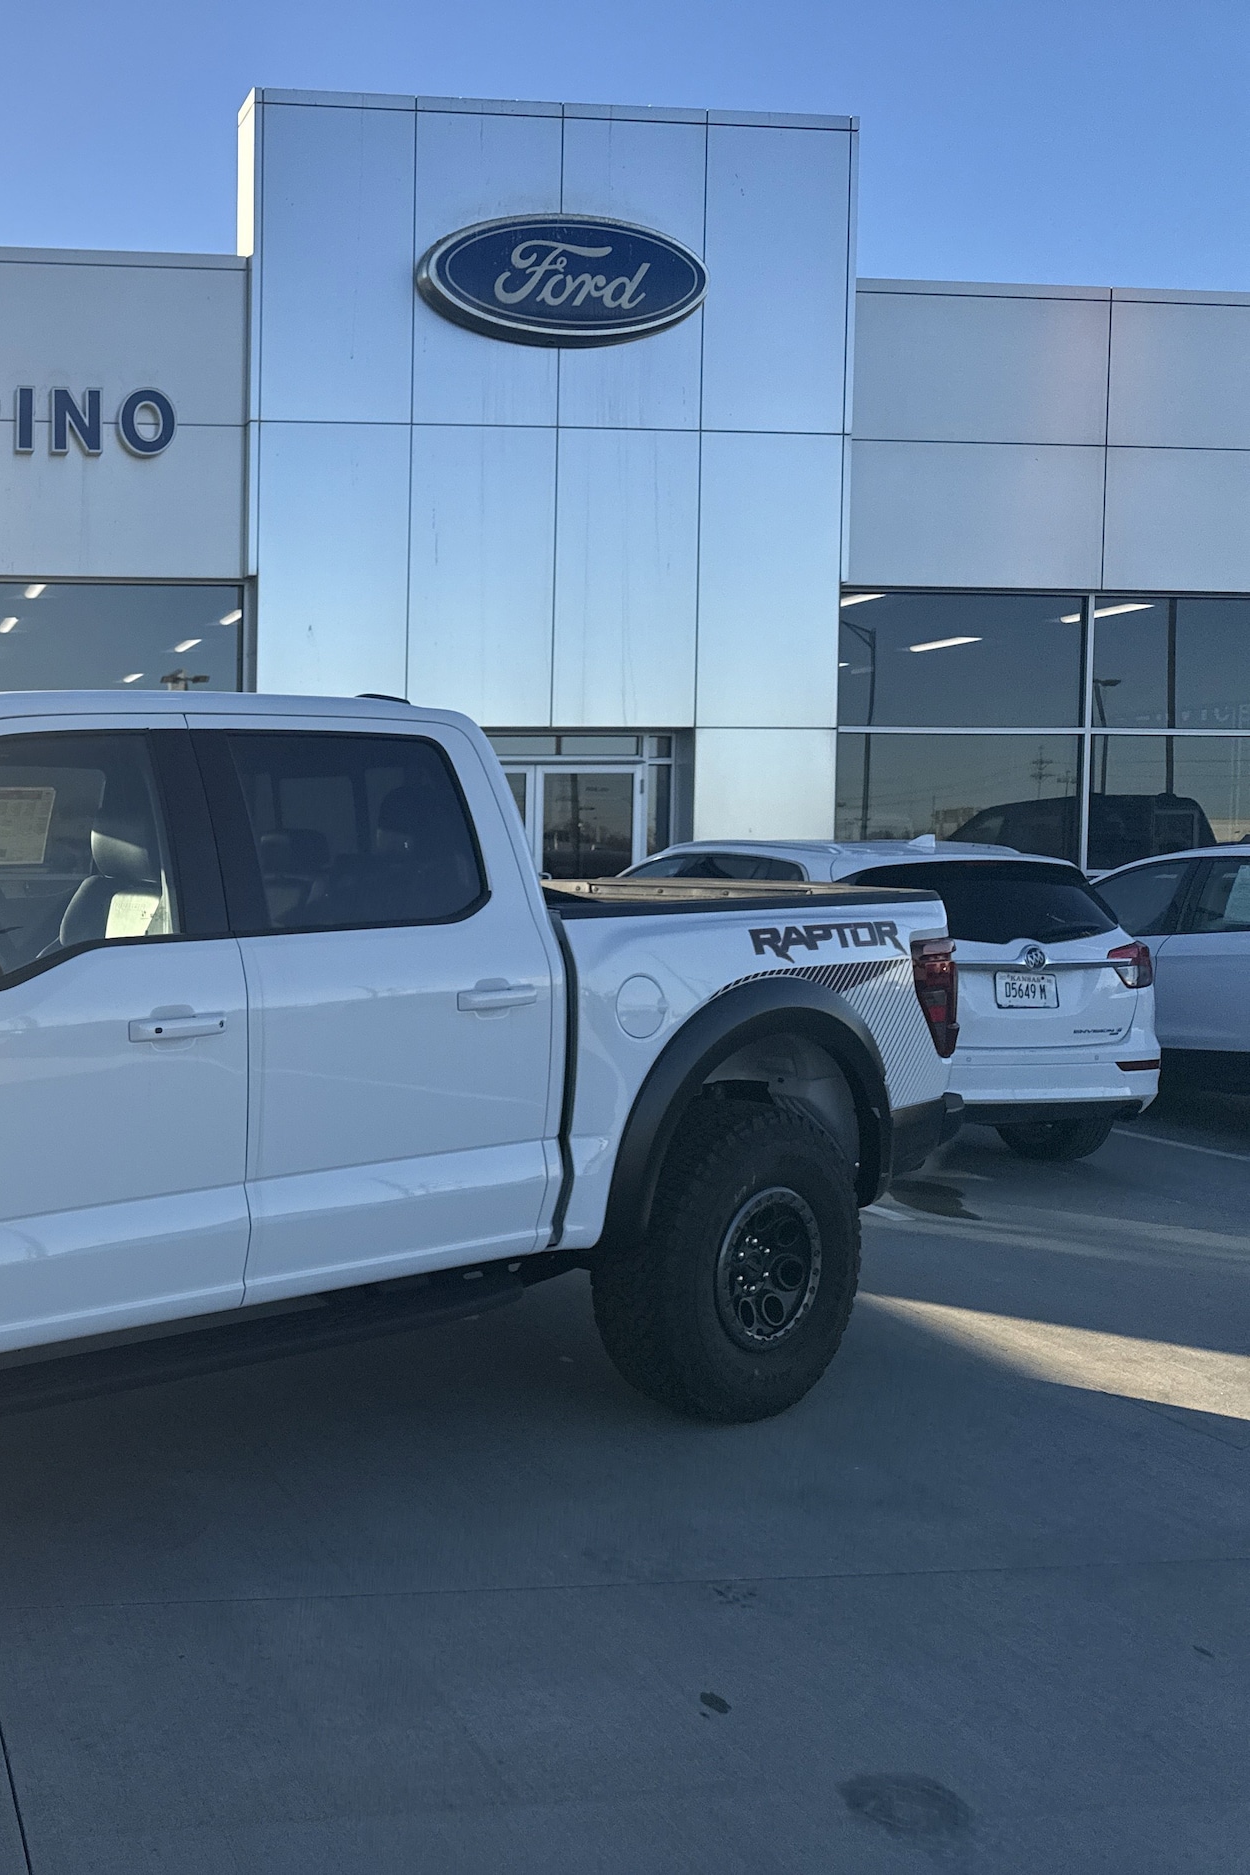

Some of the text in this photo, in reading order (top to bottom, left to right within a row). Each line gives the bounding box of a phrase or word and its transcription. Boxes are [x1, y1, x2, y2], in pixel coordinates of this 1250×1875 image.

[493, 239, 651, 310] Ford
[748, 920, 909, 964] RAPTOR
[1010, 975, 1041, 983] KANSAS
[1039, 984, 1046, 999] M
